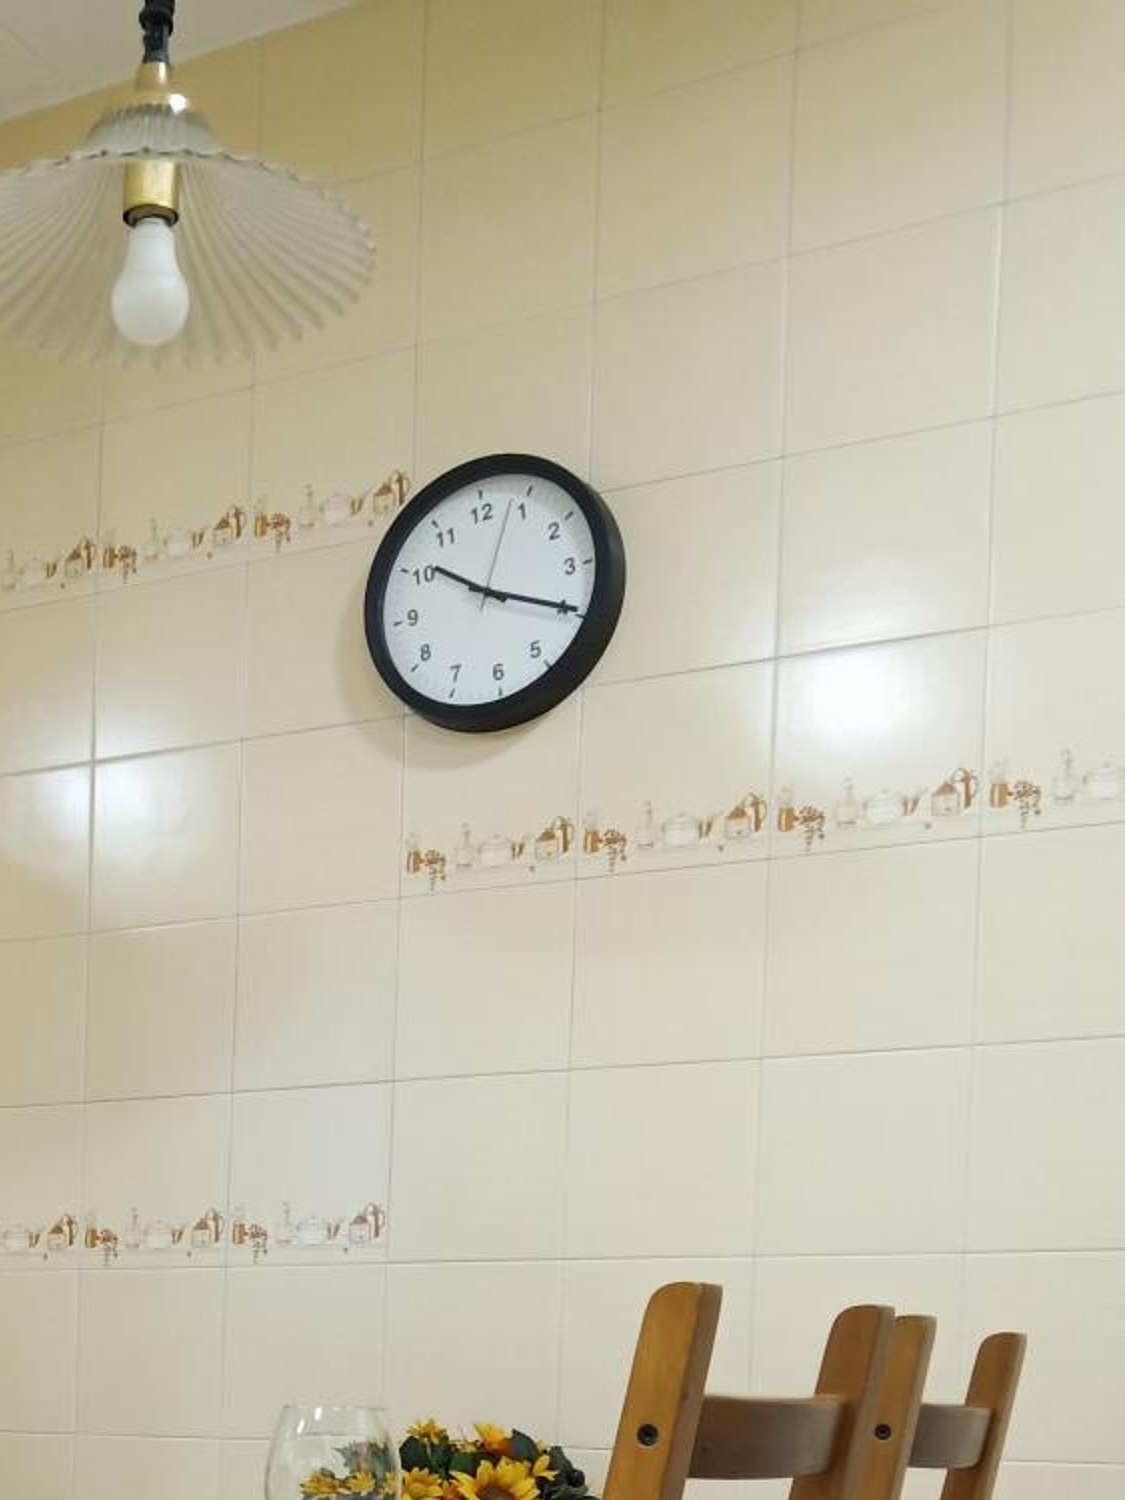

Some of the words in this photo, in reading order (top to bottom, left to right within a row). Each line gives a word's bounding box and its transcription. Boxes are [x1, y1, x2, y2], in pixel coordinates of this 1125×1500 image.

[471, 502, 493, 525] 12
[518, 503, 527, 520] 1
[436, 527, 456, 547] 11
[548, 522, 561, 541] 2
[412, 565, 435, 585] 10
[563, 557, 576, 575] 3
[407, 609, 419, 626] 9
[420, 643, 432, 661] 8
[530, 639, 542, 658] 5
[450, 663, 462, 682] 7
[492, 663, 505, 681] 6
